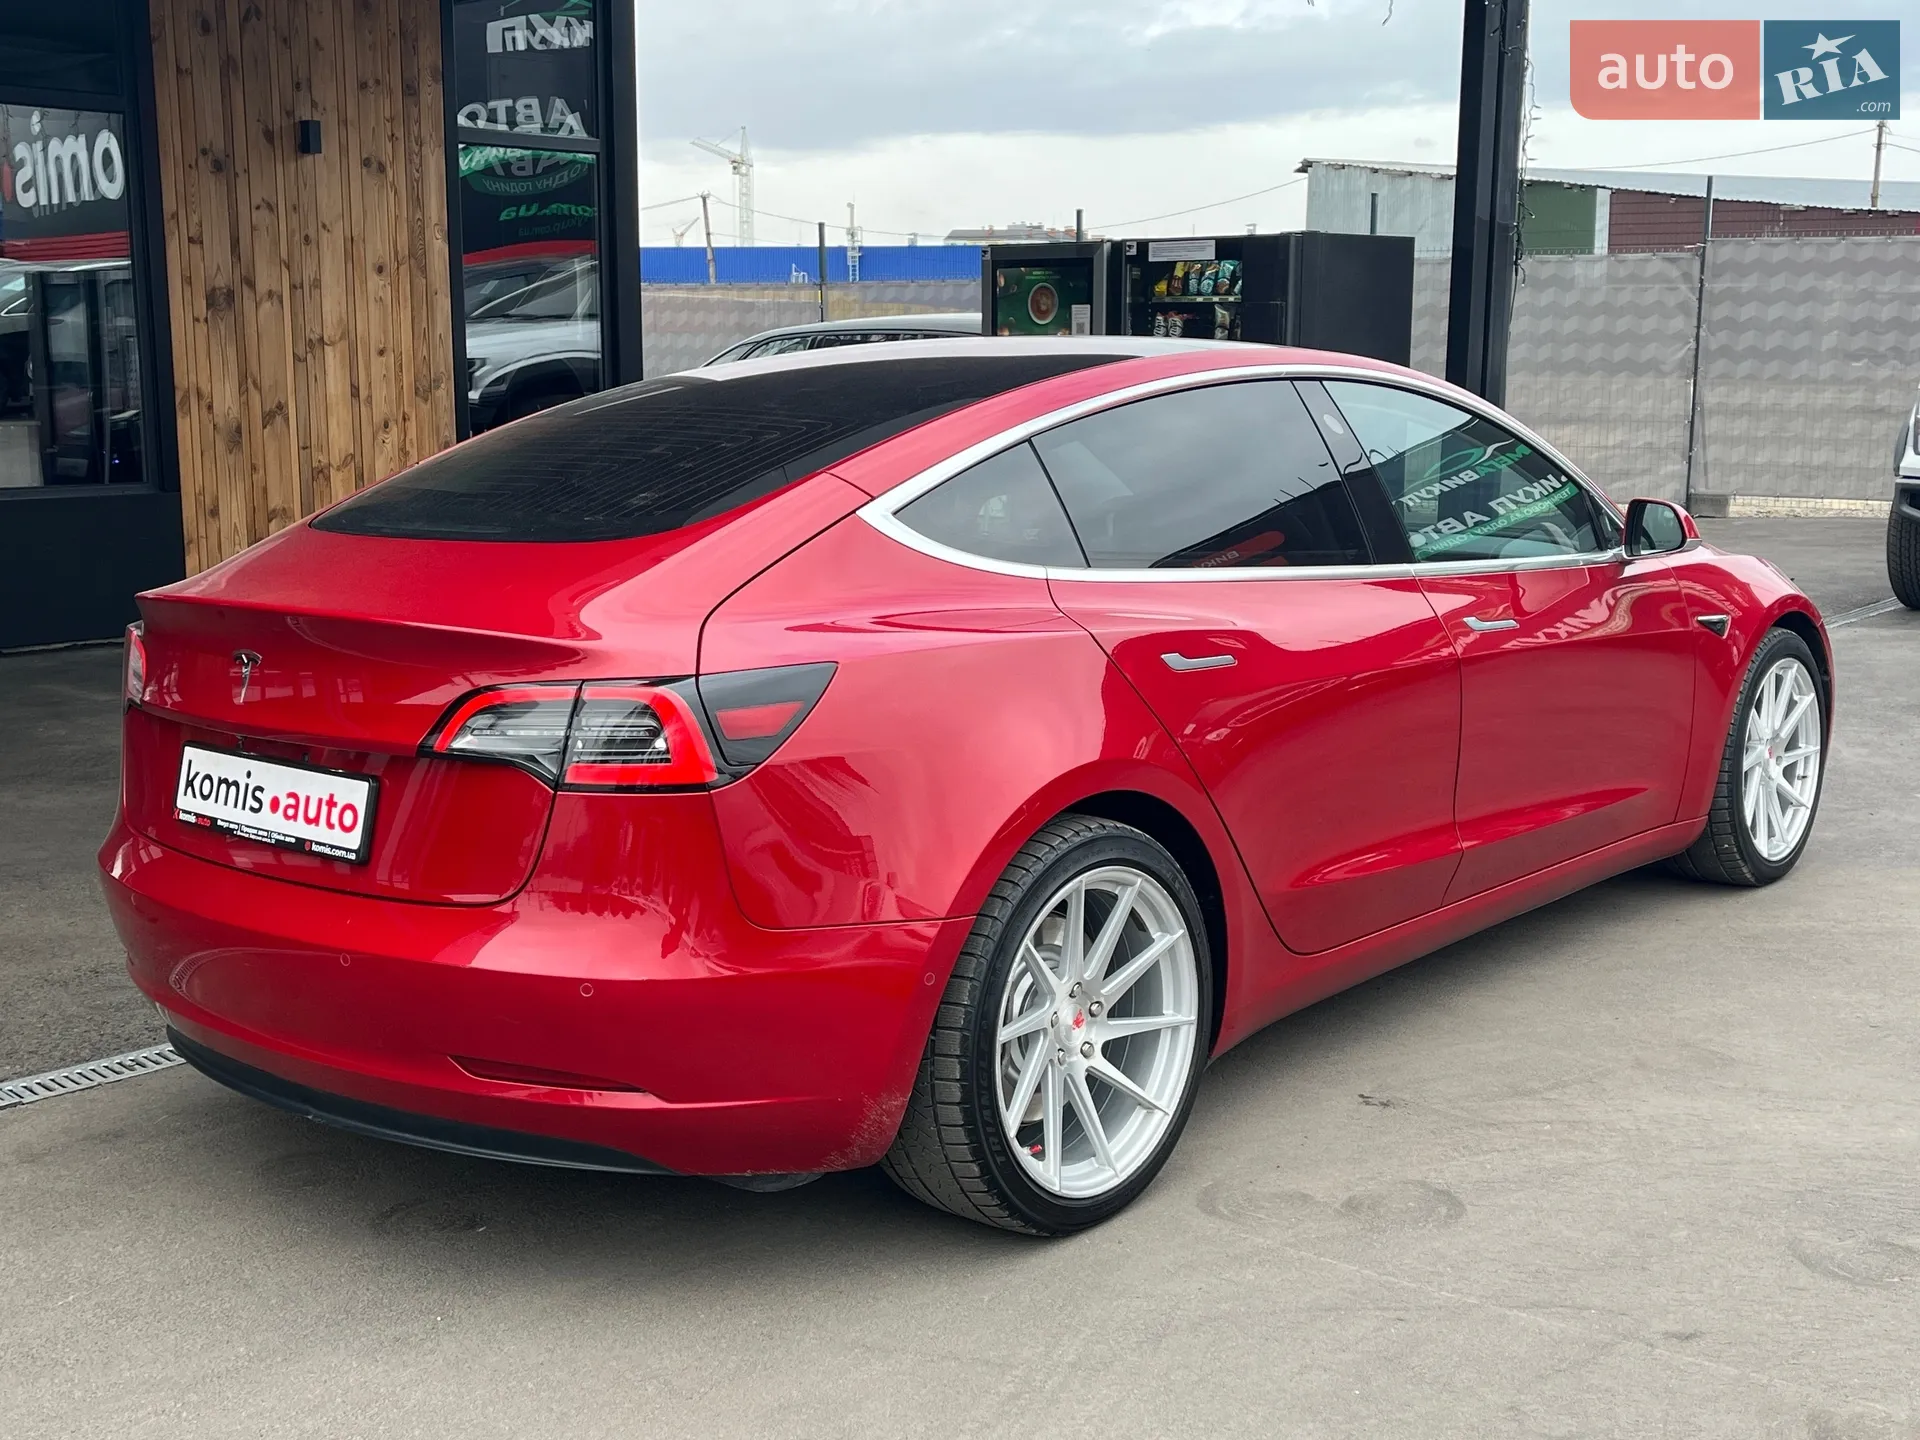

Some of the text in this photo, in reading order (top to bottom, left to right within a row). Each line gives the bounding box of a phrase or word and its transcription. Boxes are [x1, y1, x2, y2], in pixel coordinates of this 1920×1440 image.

[183, 759, 359, 834] komis auto
[311, 843, 356, 860] komis.com.ua
